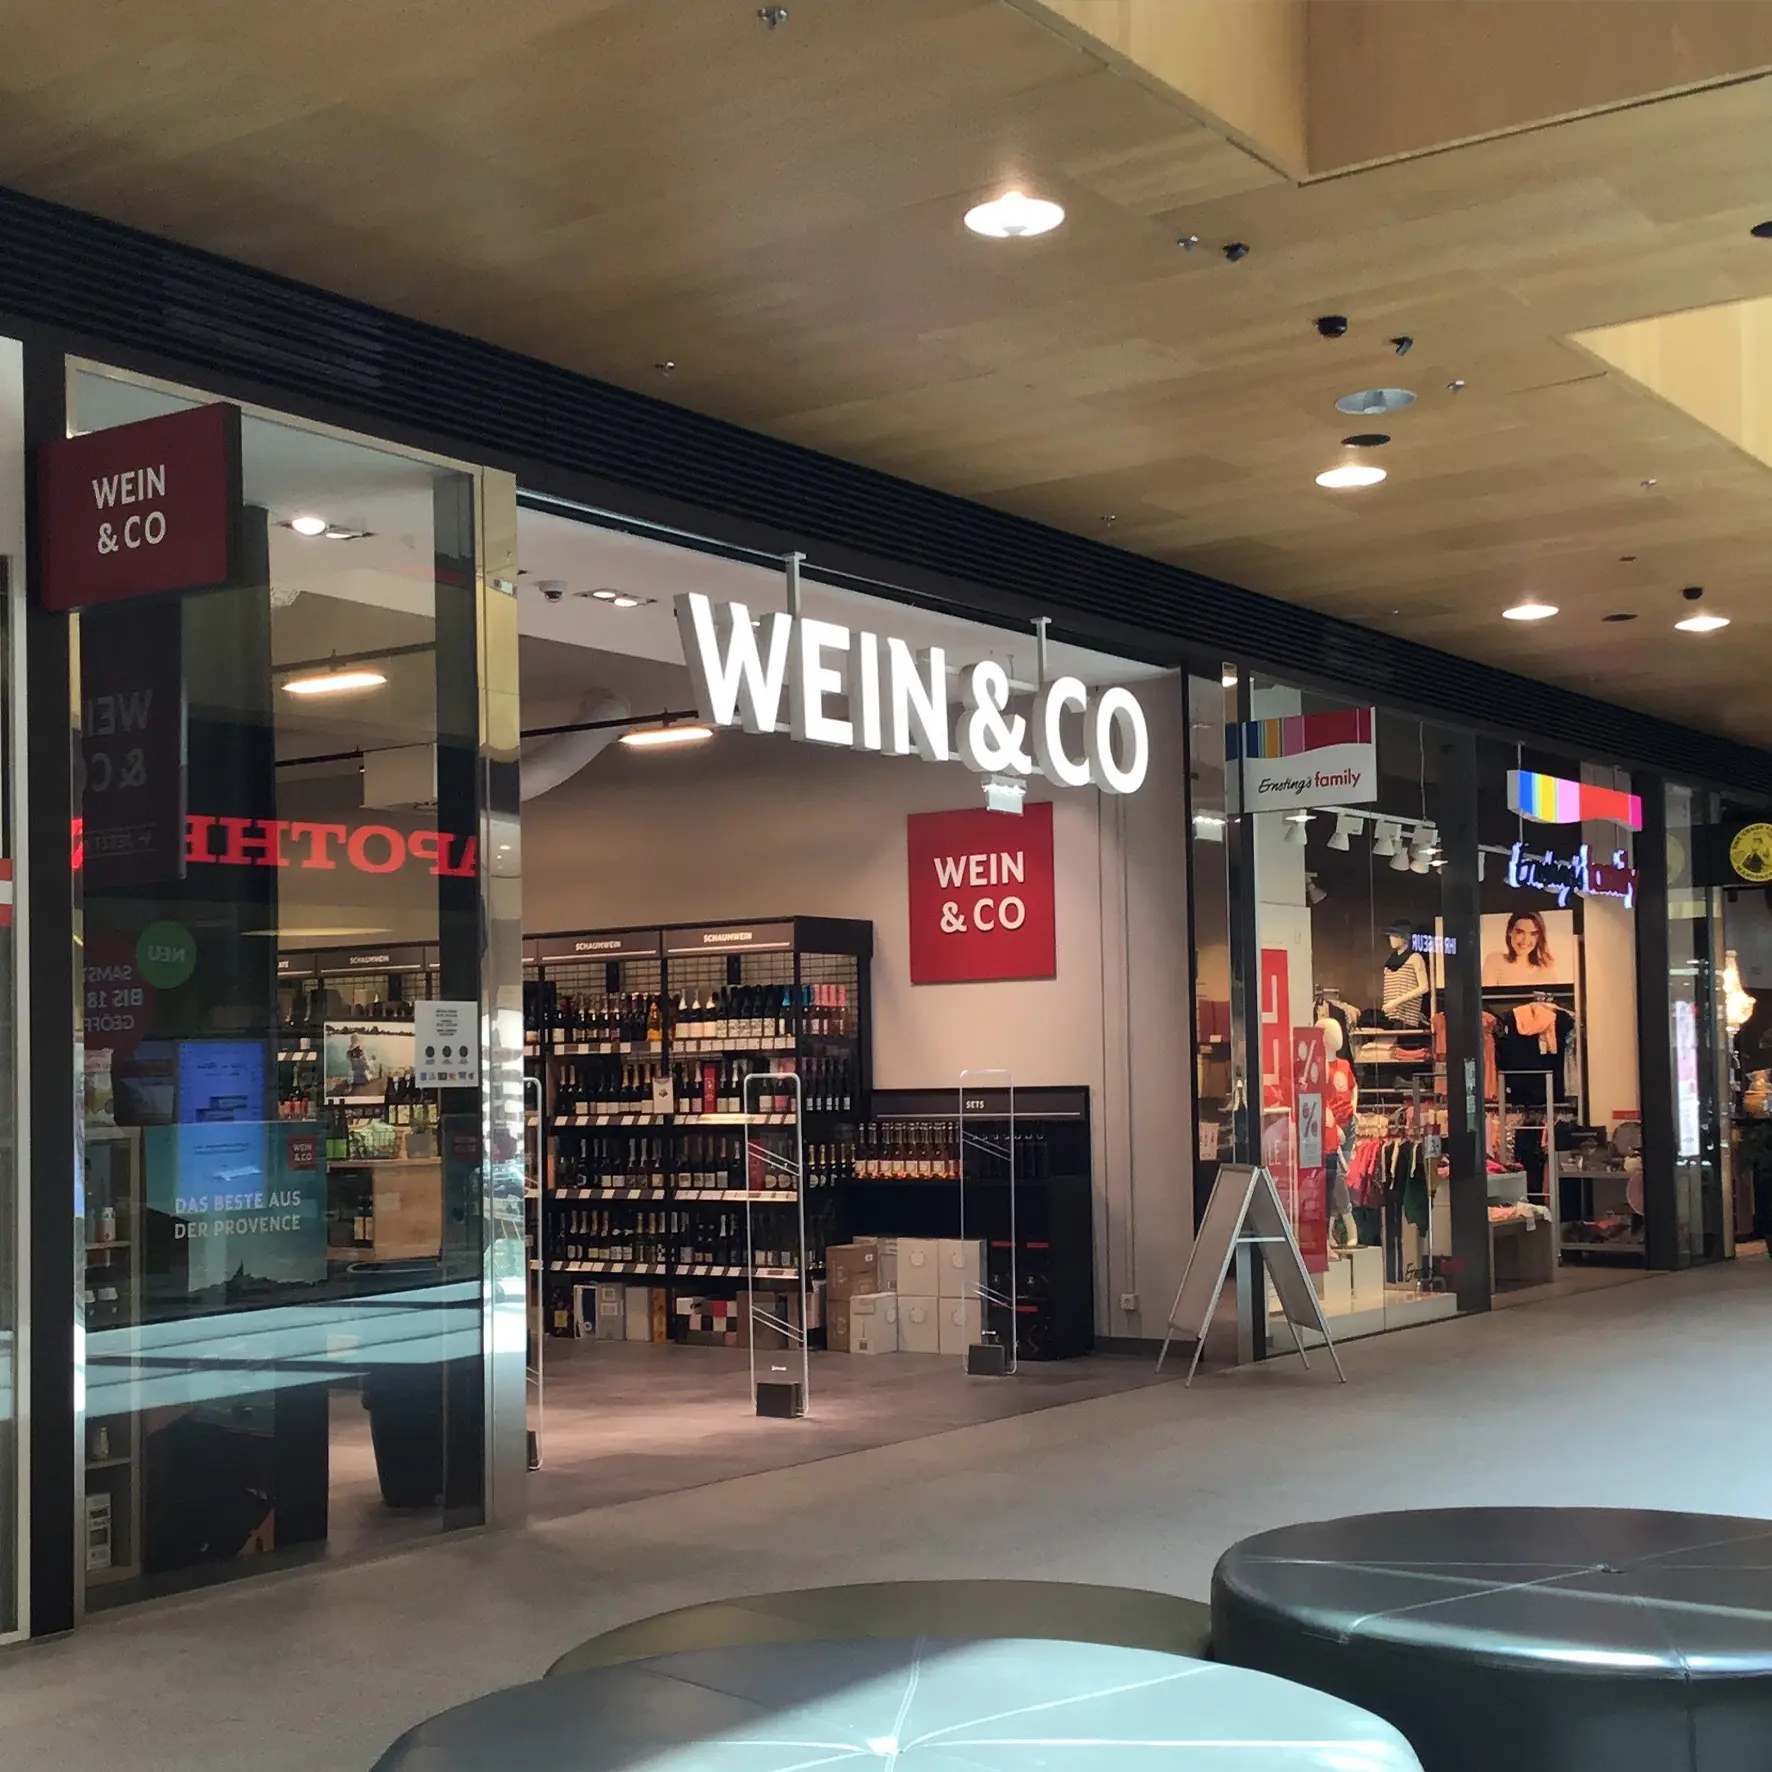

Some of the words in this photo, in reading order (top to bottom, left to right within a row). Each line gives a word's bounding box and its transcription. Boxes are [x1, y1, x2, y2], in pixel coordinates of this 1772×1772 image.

[92, 464, 165, 509] WEIN
[676, 592, 949, 761] WEIN
[1258, 777, 1312, 794] Ernsting's
[1315, 768, 1361, 788] family
[933, 851, 1025, 888] WEIN
[575, 940, 621, 951] SCHAUMWEIN
[703, 932, 752, 943] SCHAUMWEIN
[965, 1100, 985, 1110] SETS
[175, 1197, 208, 1214] DAS
[214, 1193, 263, 1210] BESTE
[269, 1190, 301, 1206] AUS
[174, 1223, 208, 1240] DER
[214, 1215, 301, 1236] PROVENCE
